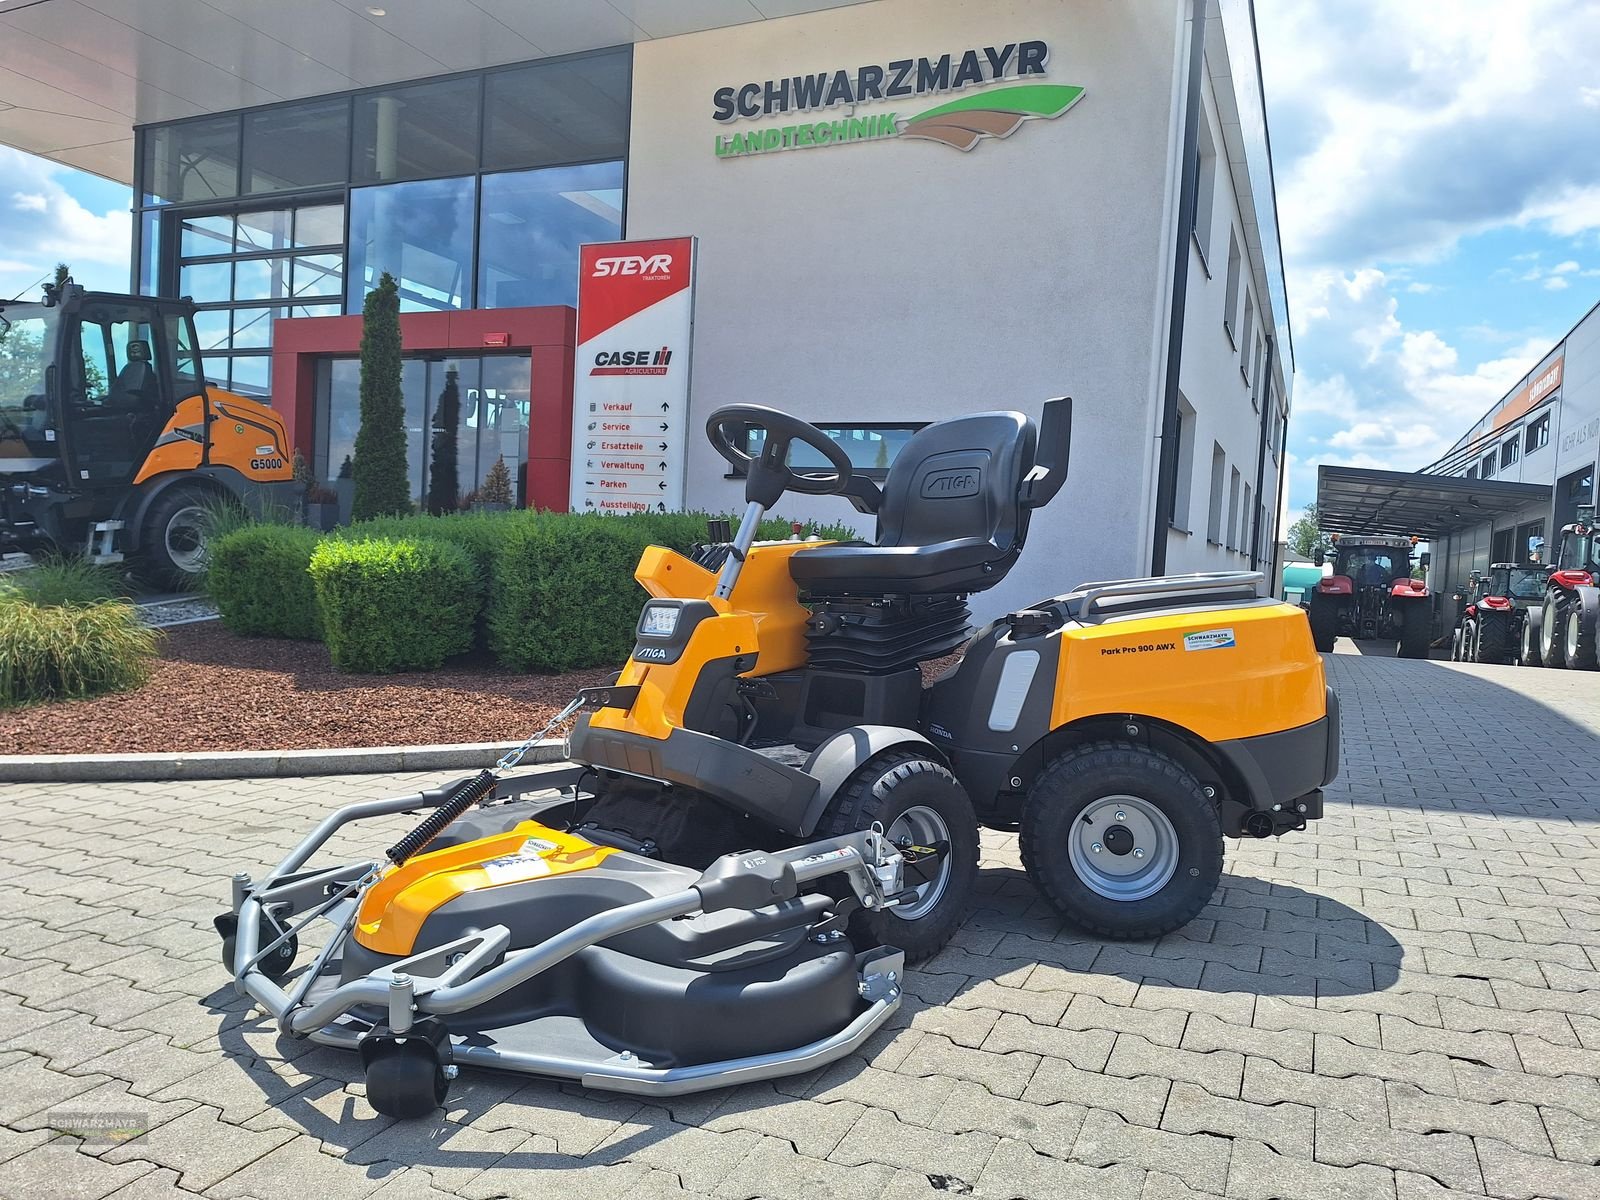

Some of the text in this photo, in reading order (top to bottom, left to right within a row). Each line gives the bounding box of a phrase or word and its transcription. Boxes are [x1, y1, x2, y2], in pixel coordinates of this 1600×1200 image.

[712, 40, 1049, 122] SCHWARZMAYR
[715, 112, 897, 157] LANDTECHNIK
[592, 254, 672, 277] STEYR
[595, 351, 650, 366] CASE
[603, 403, 632, 411] Verkauf
[601, 442, 643, 450] Ersatzteile
[250, 459, 282, 470] G5000
[601, 461, 645, 471] Verwaltung
[600, 480, 627, 489] Parken
[928, 475, 976, 491] STIGA
[600, 500, 646, 511] Ausstellung
[1188, 633, 1228, 641] SCHWARZMAYR
[637, 648, 666, 659] STIGA
[1101, 648, 1121, 656] Park
[1138, 645, 1154, 653] 900
[1155, 643, 1176, 651] AWX
[930, 726, 953, 739] HONDA
